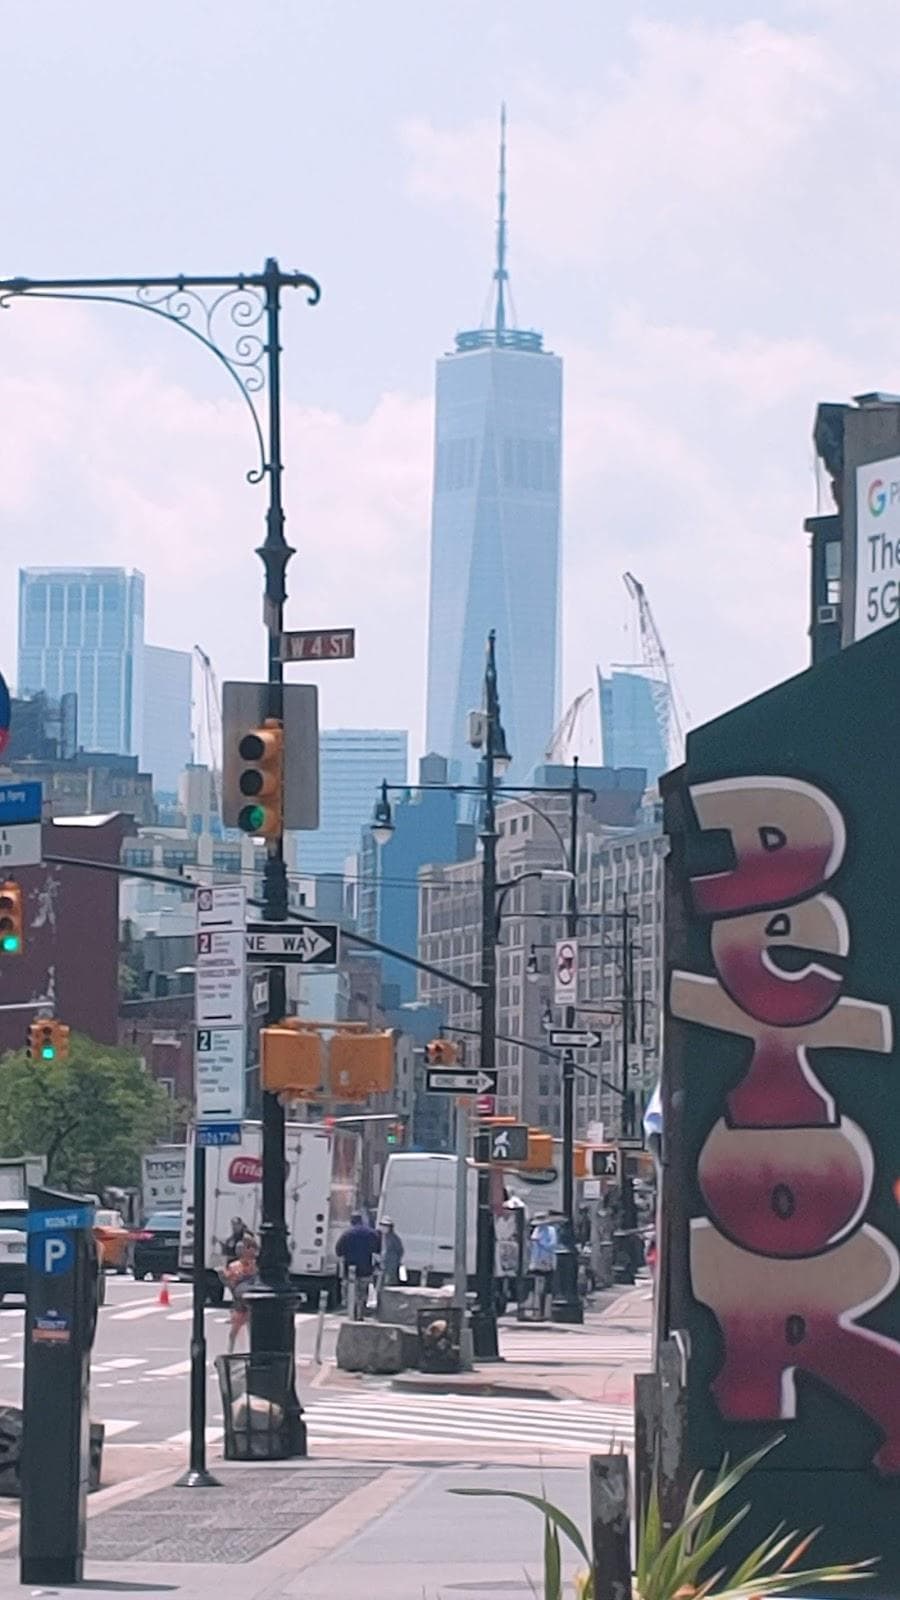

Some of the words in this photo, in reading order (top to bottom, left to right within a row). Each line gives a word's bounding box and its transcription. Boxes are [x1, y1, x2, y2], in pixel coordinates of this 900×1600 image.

[868, 479, 886, 517] G
[890, 482, 900, 505] P
[868, 532, 900, 573] The
[867, 580, 900, 623] 5G
[290, 637, 304, 657] W
[310, 636, 322, 655] 4
[330, 634, 350, 657] ST
[246, 935, 266, 951] NE
[282, 936, 319, 952] WAY
[199, 1031, 209, 1051] 2
[44, 1238, 67, 1272] P
